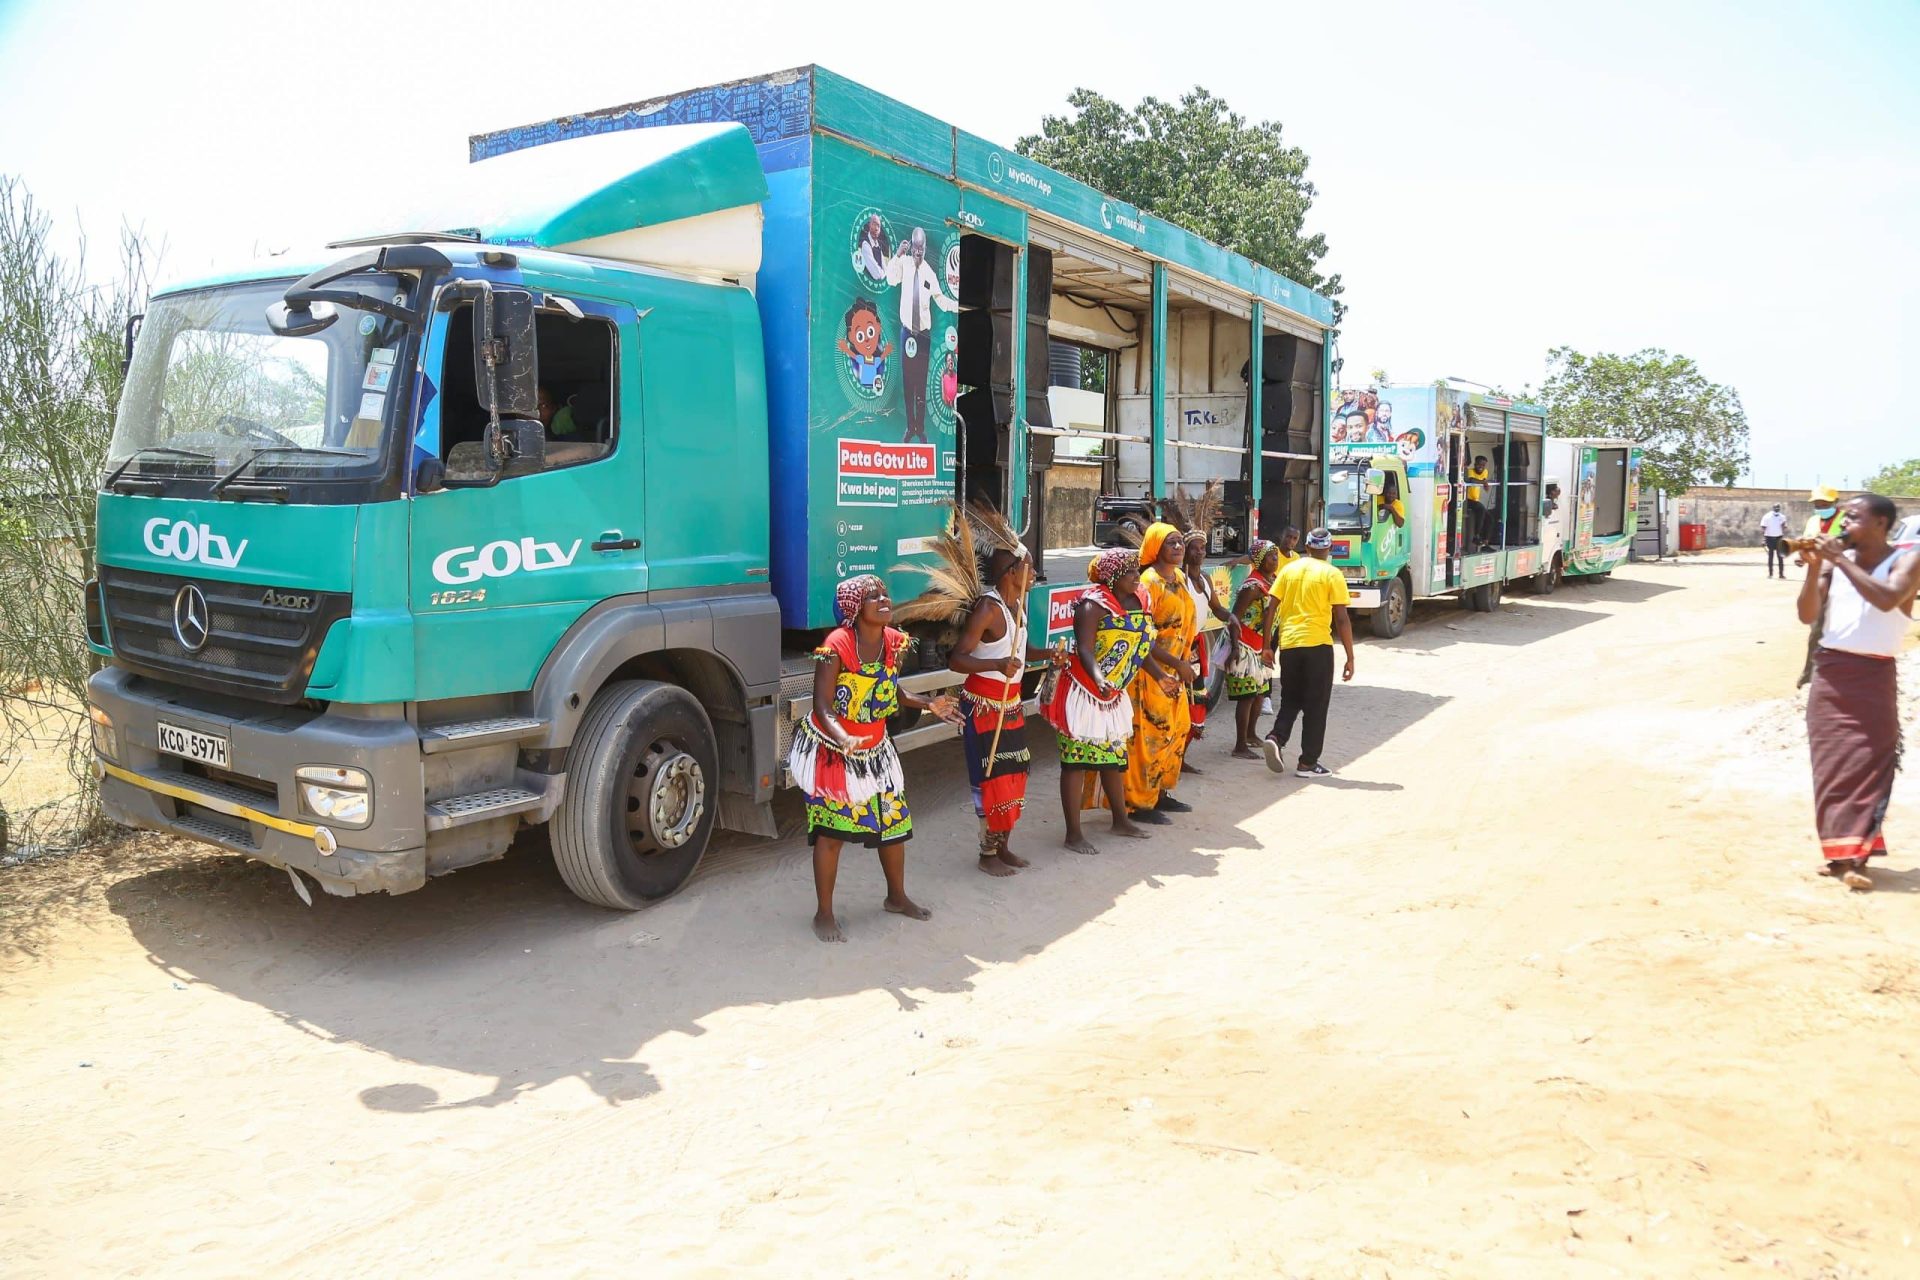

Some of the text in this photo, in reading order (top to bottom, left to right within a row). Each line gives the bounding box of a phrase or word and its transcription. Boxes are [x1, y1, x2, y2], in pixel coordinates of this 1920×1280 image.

[1008, 167, 1052, 197] MyGOtv App
[841, 449, 928, 470] Pata GOtv Lite
[840, 482, 896, 500] Kwa bei poa
[143, 517, 248, 568] GOtv
[431, 536, 583, 585] GOtv
[159, 727, 227, 764] KCQ 597H
